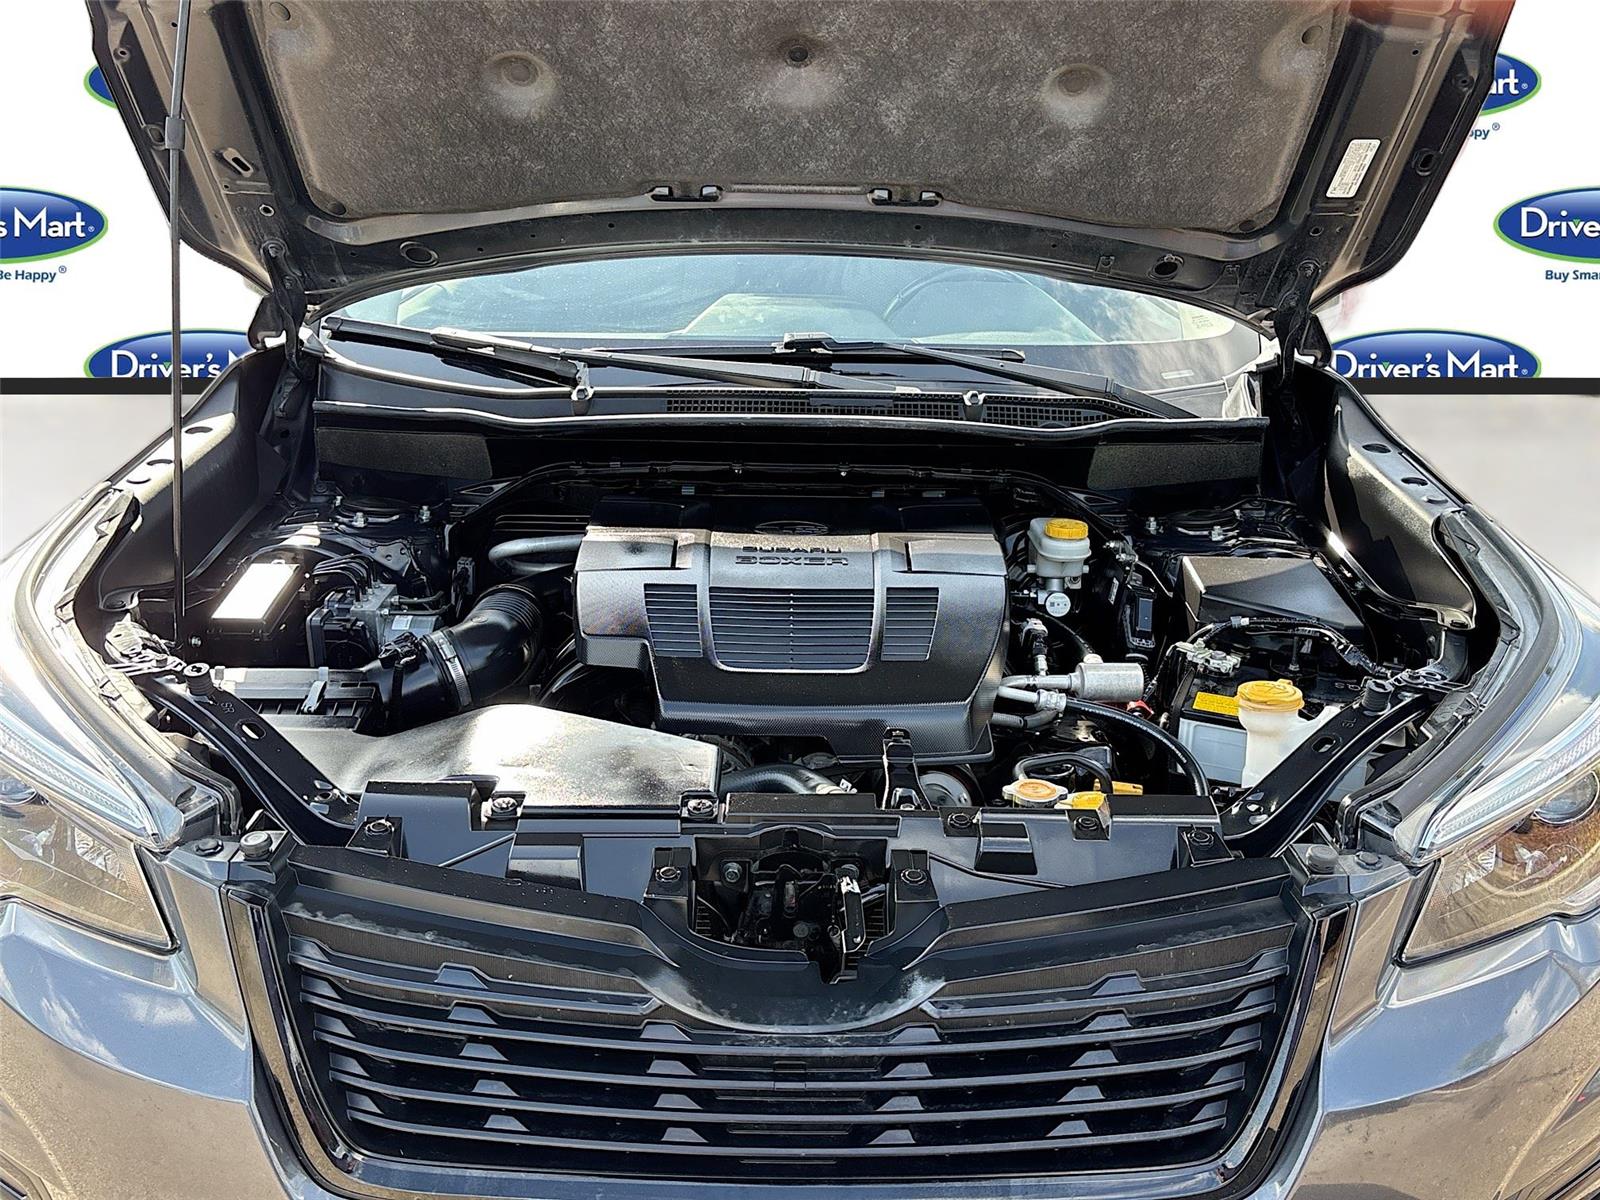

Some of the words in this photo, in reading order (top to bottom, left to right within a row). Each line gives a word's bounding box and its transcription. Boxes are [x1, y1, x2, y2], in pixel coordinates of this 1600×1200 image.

[14, 206, 86, 237] Mart
[15, 270, 57, 283] Happy
[1545, 270, 1570, 283] Buy
[1572, 270, 1600, 280] Sma
[111, 350, 221, 378] Driver's
[1333, 350, 1441, 378] Driver's
[1447, 349, 1519, 378] Mart
[742, 545, 842, 554] SUBARU
[735, 555, 849, 566] BOXER
